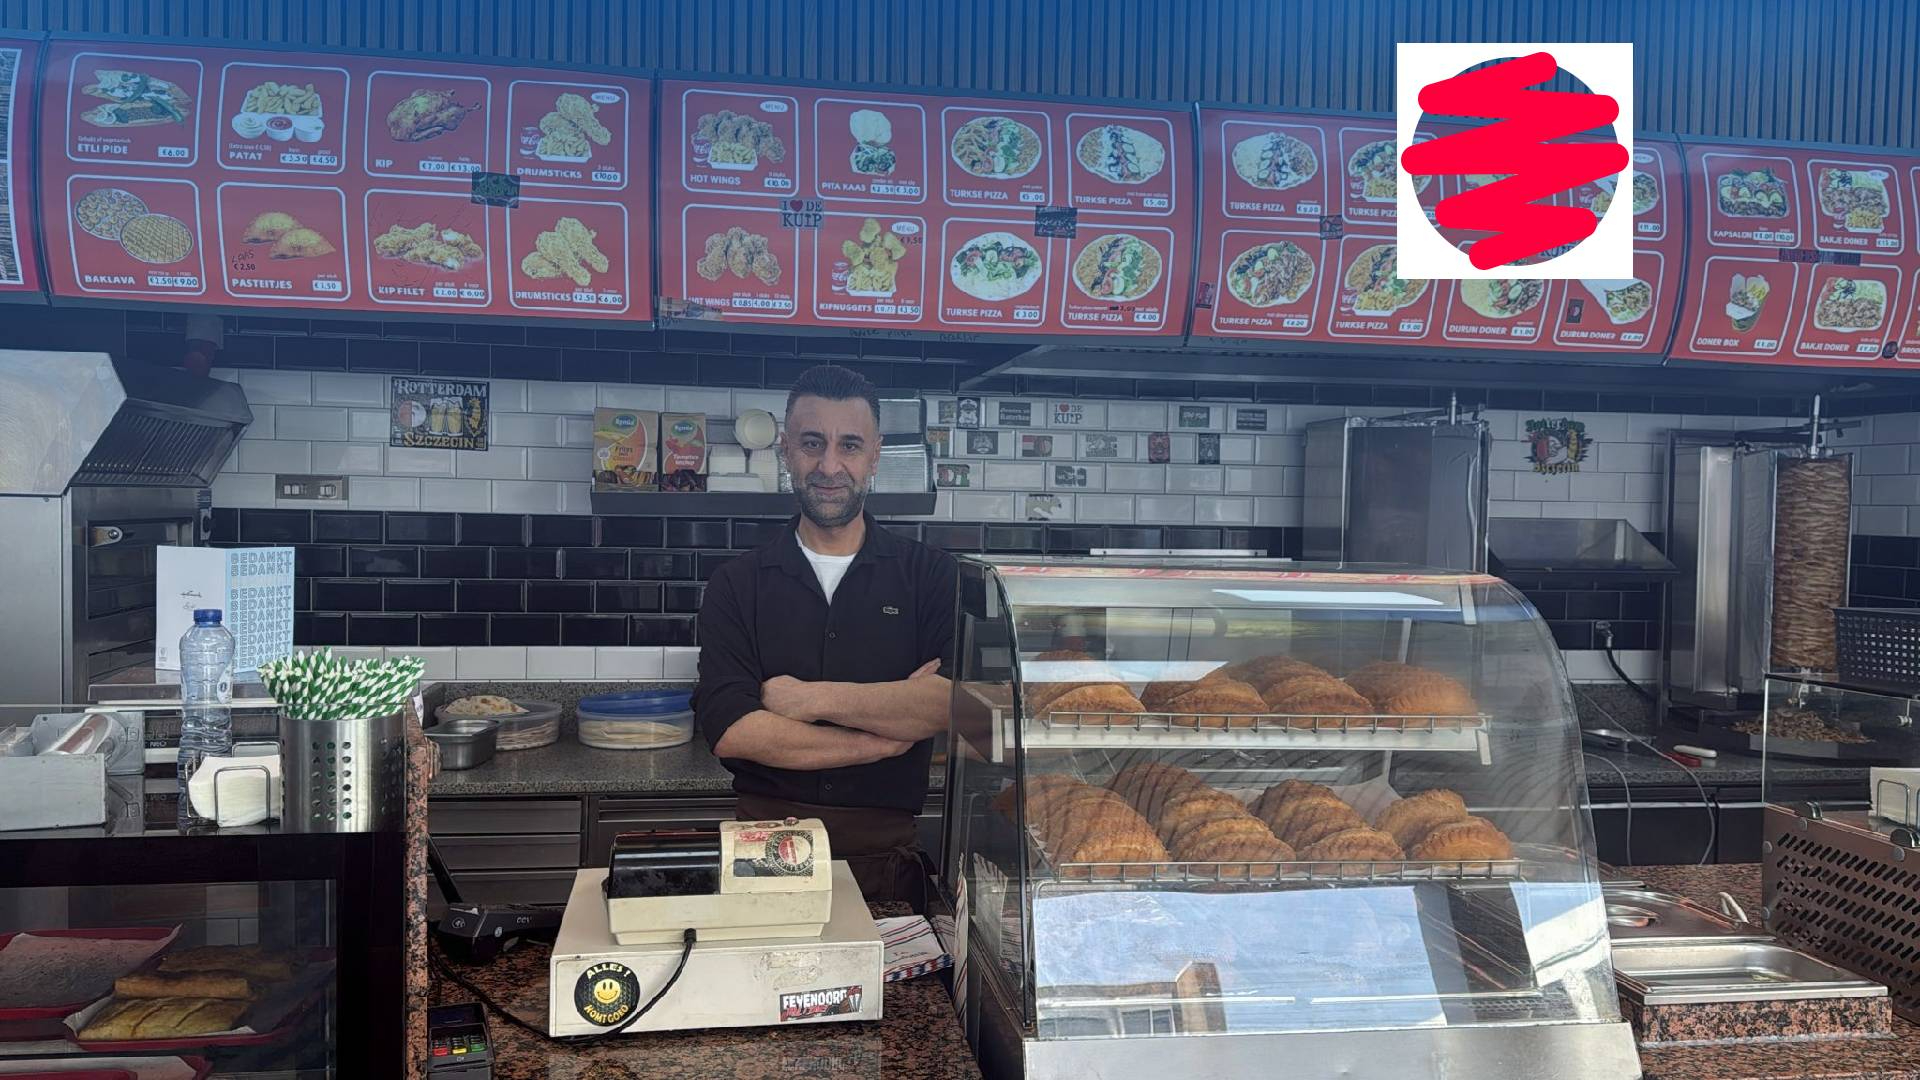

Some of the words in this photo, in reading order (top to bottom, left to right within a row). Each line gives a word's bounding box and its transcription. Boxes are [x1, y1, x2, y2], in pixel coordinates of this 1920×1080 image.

[77, 143, 100, 152] ETLI
[103, 144, 128, 154] PIDE
[162, 147, 186, 157] €6.00
[229, 151, 262, 161] PATAT
[375, 159, 393, 168] KIP
[516, 168, 582, 179] DRUMSTICKS
[690, 174, 709, 184] HOT
[711, 176, 741, 185] WINGS
[821, 182, 841, 190] PITA
[843, 183, 866, 192] KAAS
[950, 189, 983, 199] TURKSE
[984, 190, 1009, 200] PIZZA
[1074, 196, 1107, 204] TURKSE
[1109, 197, 1132, 205] PIZZA
[806, 201, 823, 212] DE
[1229, 202, 1262, 211] TURKSE
[1263, 203, 1286, 212] PIZZA
[1349, 207, 1379, 216] TURKSE
[1381, 208, 1397, 217] PIZZ
[783, 213, 822, 227] KUIP
[1713, 230, 1752, 240] KAPSALON
[84, 275, 136, 285] BAKLAVA
[232, 278, 293, 289] PASTEITJES
[515, 291, 571, 302] DRUMSTICKS
[705, 298, 730, 307] WINGS
[819, 303, 872, 312] KIPNUGGETS
[946, 308, 978, 317] TURKSE
[980, 309, 1003, 318] PIZZA
[1068, 312, 1099, 321] TURKSE
[1101, 313, 1123, 321] PIZZA
[1219, 317, 1249, 325] TURKSE
[1251, 318, 1273, 326] PIZZA
[1335, 321, 1366, 329] TURKSE
[1366, 321, 1388, 330] PIZZA
[1723, 338, 1740, 347] BOX
[394, 379, 487, 397] ROTTERDAM
[1071, 404, 1083, 413] DE
[1054, 412, 1083, 424] KUIP
[403, 431, 474, 449] SZCZECIN
[230, 551, 292, 565] BEDANKT
[230, 562, 292, 577] BEDANKT
[230, 586, 292, 600] BEDANKT
[230, 597, 291, 611] BEDANKT
[230, 608, 291, 622] BEDANKT
[583, 1004, 607, 1024] KOMT
[607, 1004, 630, 1024] GOED
